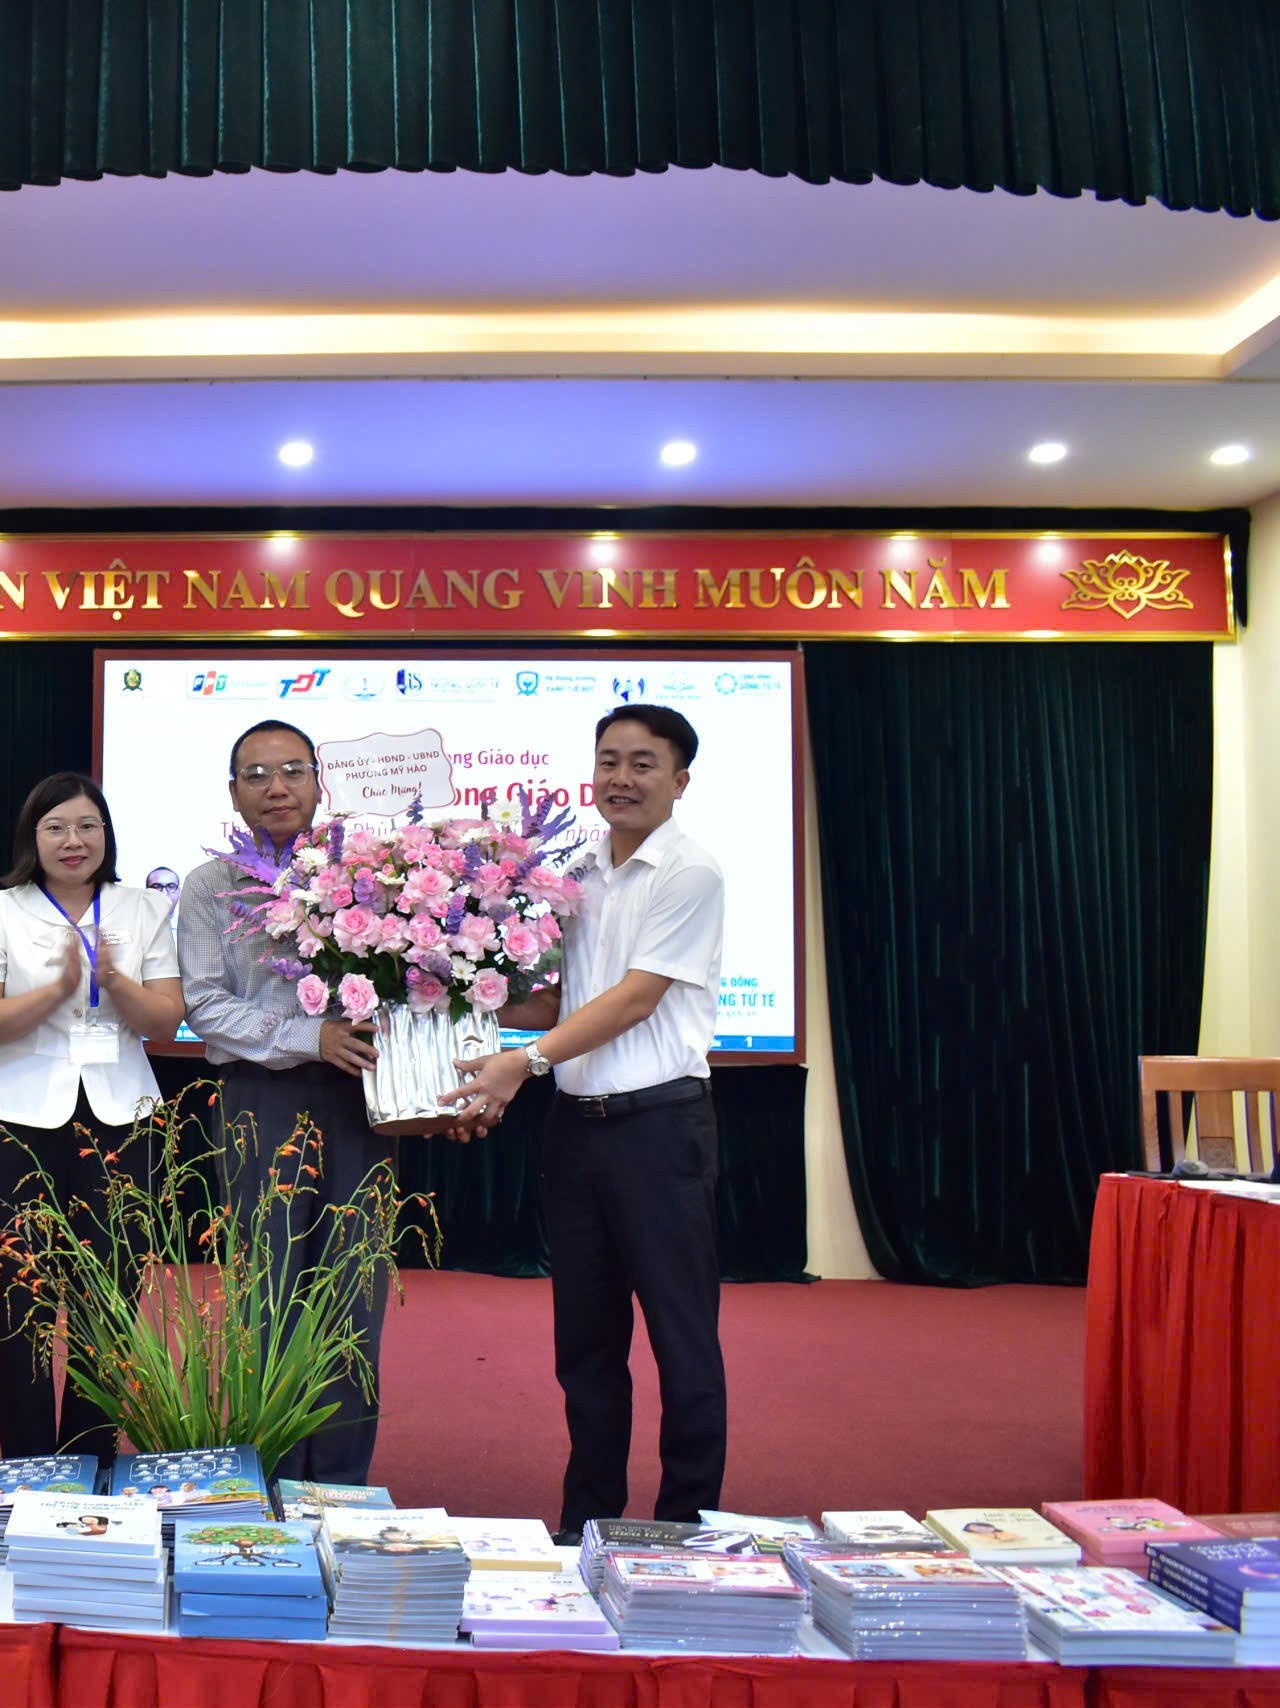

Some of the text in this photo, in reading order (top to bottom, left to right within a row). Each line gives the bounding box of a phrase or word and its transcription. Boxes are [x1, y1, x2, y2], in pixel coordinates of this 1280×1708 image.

[41, 557, 170, 621] VIỆT
[183, 568, 311, 609] NAM
[324, 568, 524, 618] QUANG
[538, 567, 680, 609] VINH
[694, 556, 864, 609] MUÔN
[879, 556, 1011, 609] NĂM
[327, 759, 355, 770] ĐẢNG
[357, 756, 369, 767] ỦY
[377, 754, 405, 764] HĐND
[413, 750, 440, 761] UBND
[407, 763, 428, 773] HÀO
[478, 749, 514, 765] Giáo
[520, 750, 549, 769] dục
[565, 823, 609, 842] nhâ
[718, 992, 736, 1006] NG
[745, 1035, 753, 1048] 1
